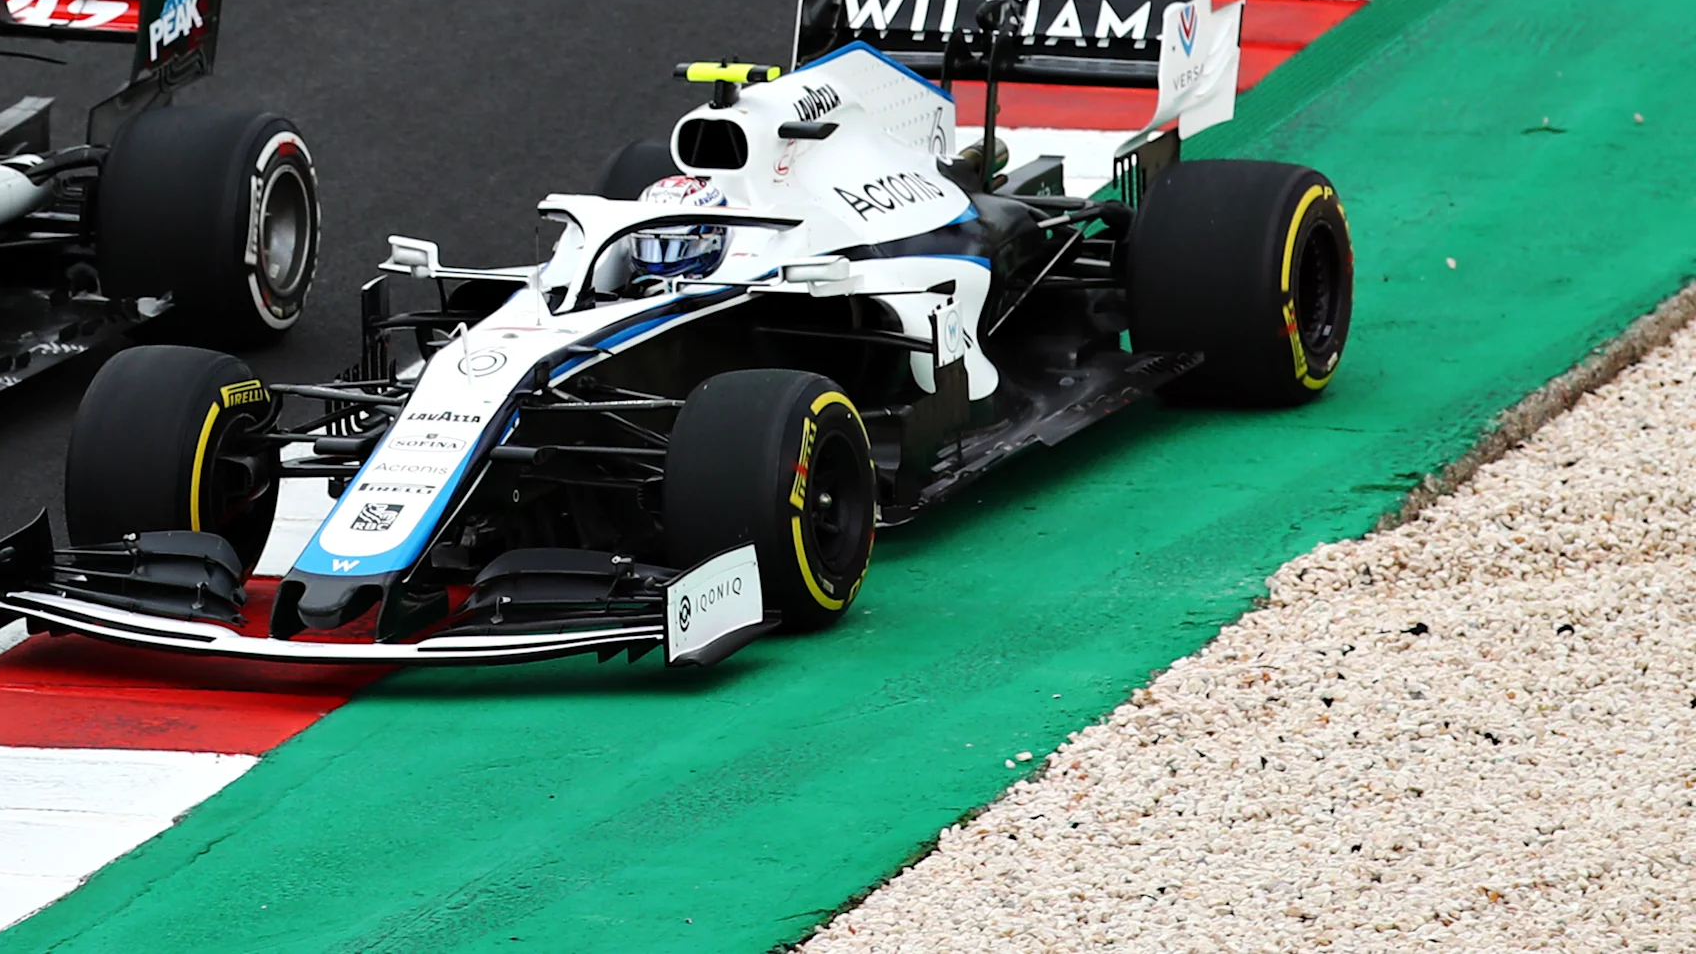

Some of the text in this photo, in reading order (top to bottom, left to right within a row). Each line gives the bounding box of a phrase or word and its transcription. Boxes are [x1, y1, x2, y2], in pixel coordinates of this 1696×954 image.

[928, 106, 948, 163] 6
[833, 170, 946, 222] Acronis
[219, 379, 264, 409] PIRELLI
[407, 411, 481, 423] LAVAZZA
[395, 440, 458, 450] SOFINA
[372, 462, 449, 475] Acronis
[357, 482, 437, 495] PIRELLI
[351, 521, 390, 531] RBC
[331, 558, 361, 573] W
[695, 576, 743, 614] IQONIQ
